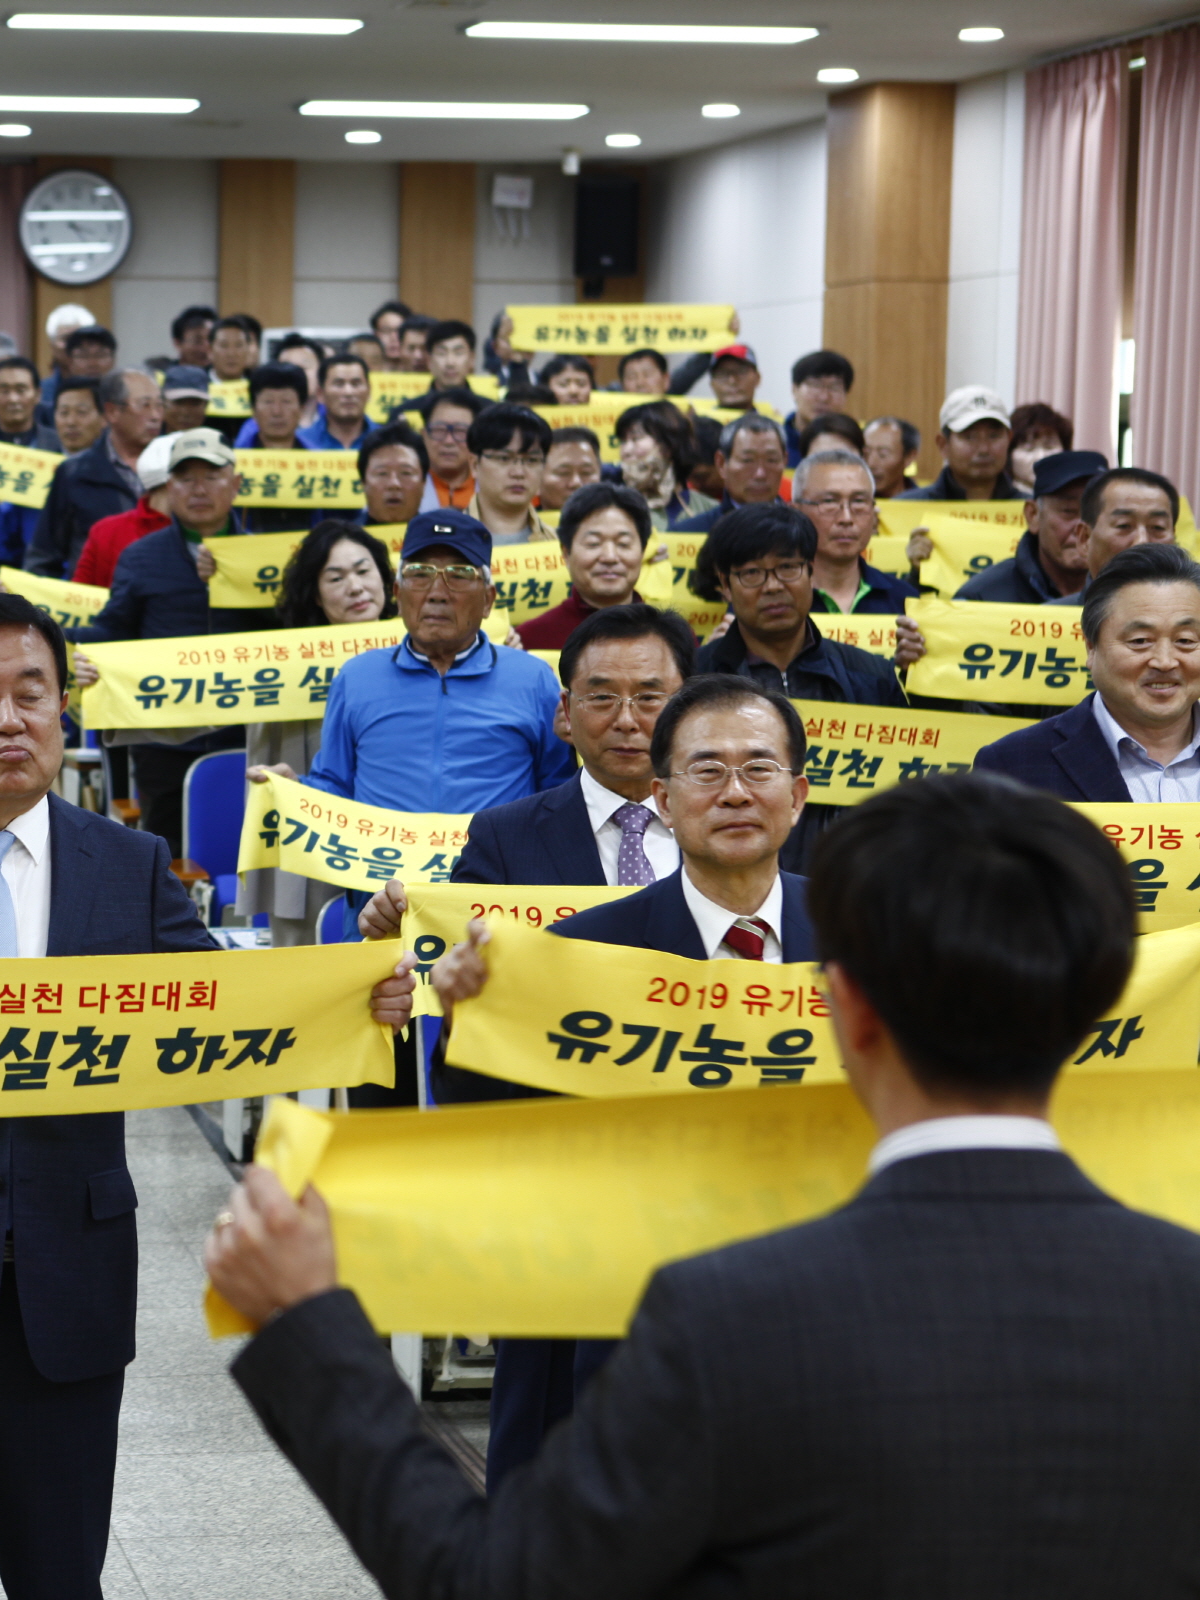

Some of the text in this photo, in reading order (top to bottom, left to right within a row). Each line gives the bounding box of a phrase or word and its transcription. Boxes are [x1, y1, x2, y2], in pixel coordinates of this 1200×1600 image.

[291, 475, 342, 499] 실천
[1010, 619, 1063, 639] 2019
[177, 649, 226, 666] 2019
[232, 644, 290, 664] 유기농
[298, 640, 335, 659] 실천
[135, 667, 285, 711] 유기농을
[805, 718, 941, 749] 실천 다짐대회
[300, 798, 348, 829] 2019
[356, 818, 418, 845] 유기농
[77, 980, 219, 1014] 다짐대회
[647, 976, 729, 1010] 2019
[155, 1026, 297, 1075] 하자
[546, 1010, 817, 1089] 유기농을
